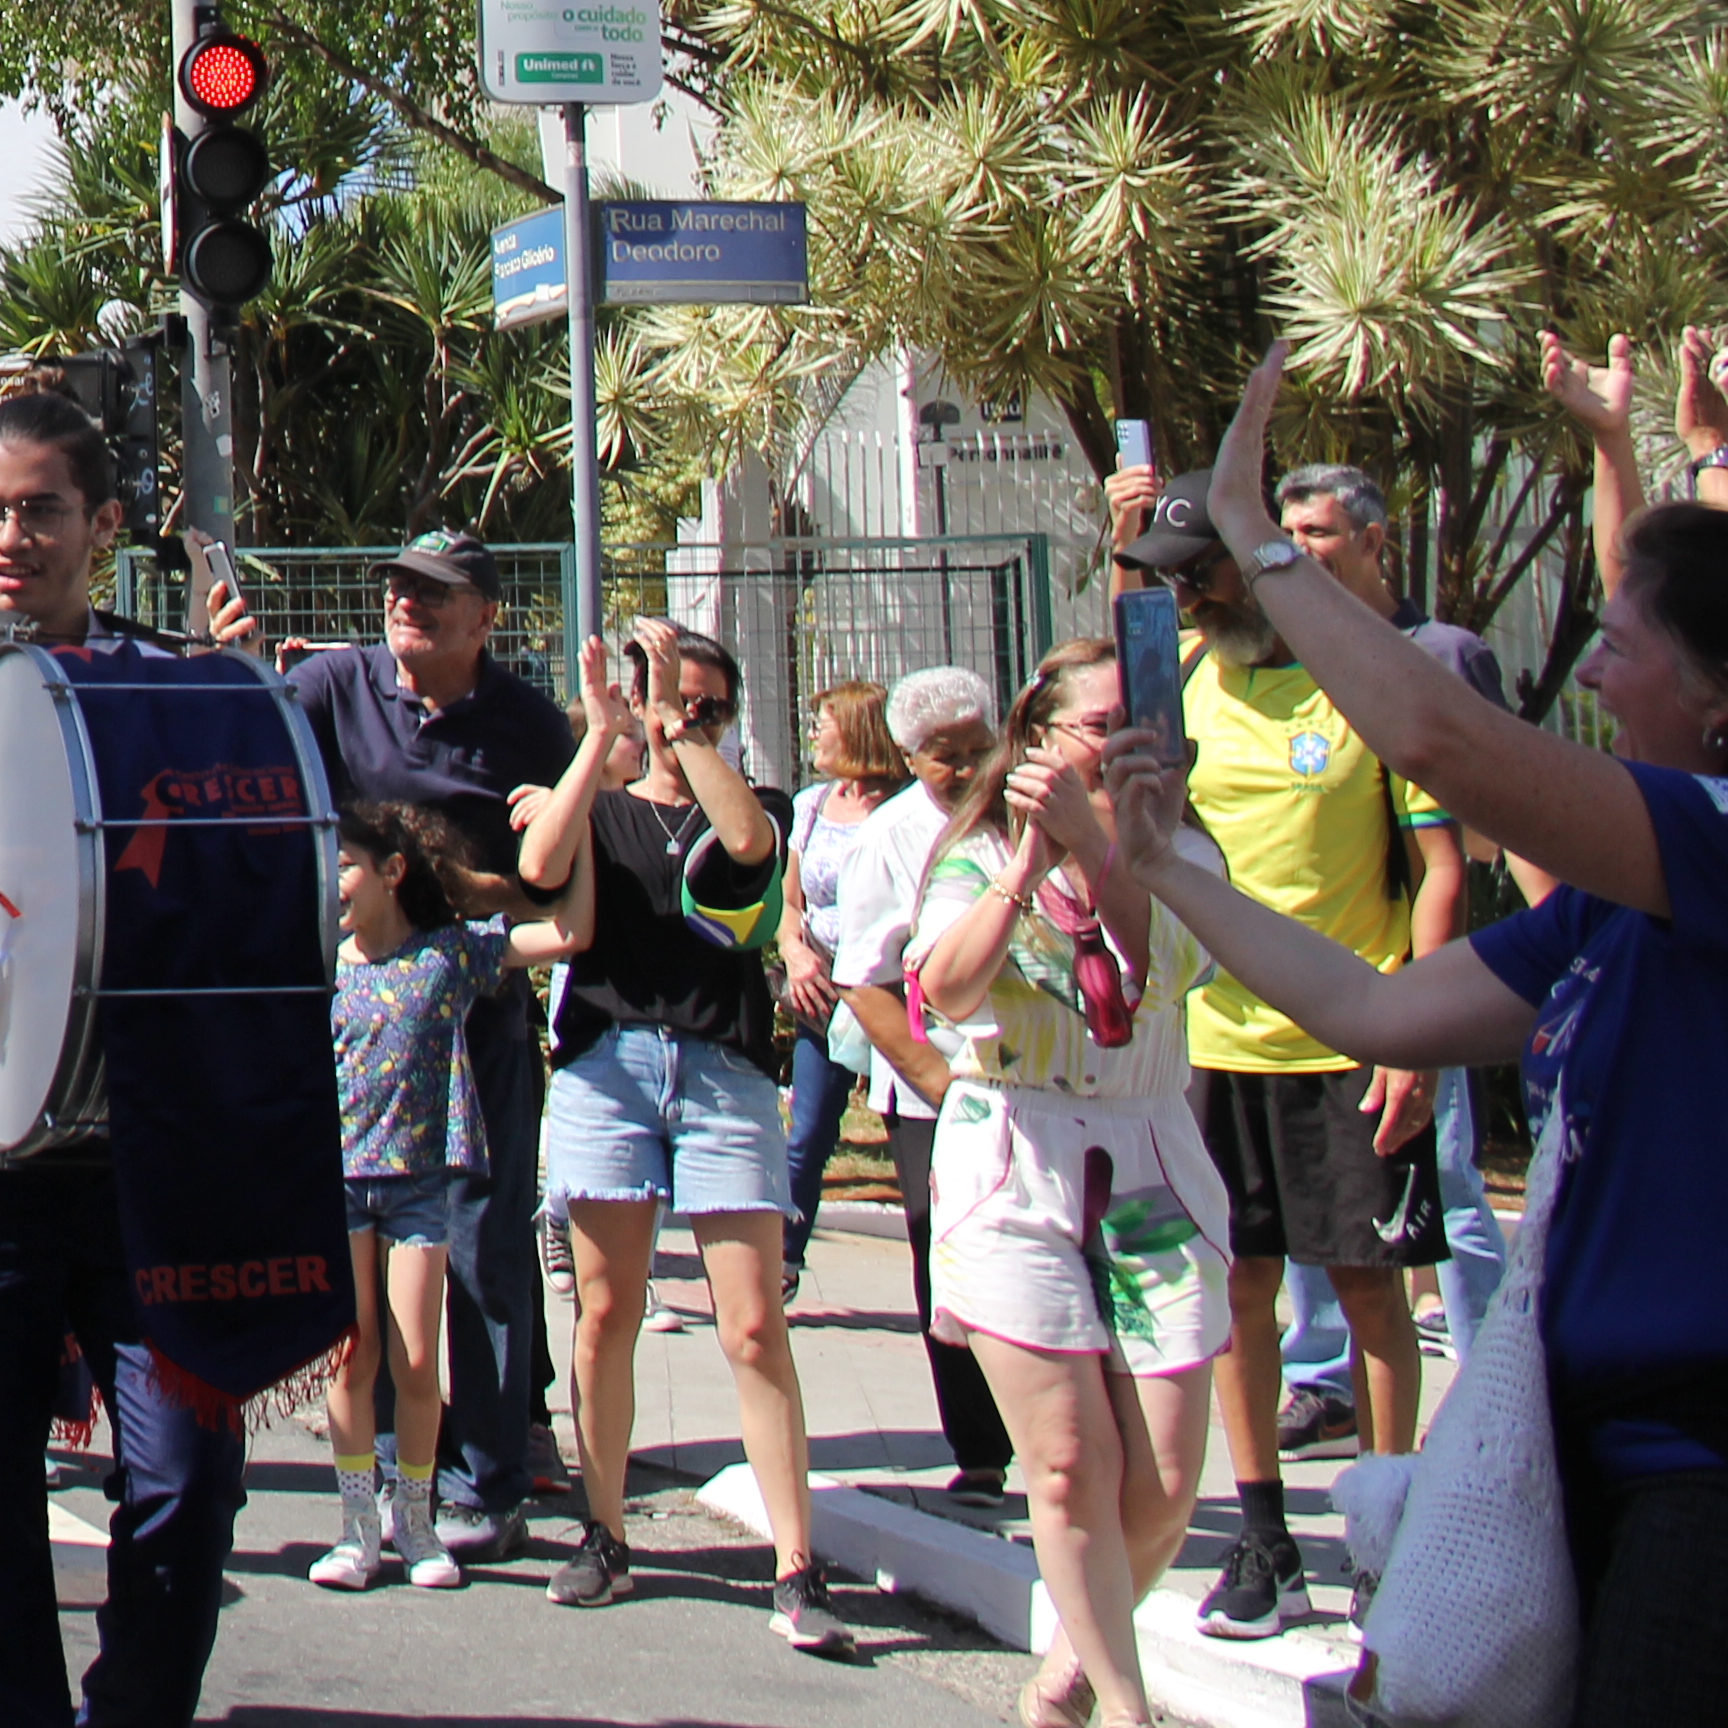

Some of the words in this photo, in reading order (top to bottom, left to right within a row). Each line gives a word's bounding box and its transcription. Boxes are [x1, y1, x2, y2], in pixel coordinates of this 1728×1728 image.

[500, 0, 534, 11] Nosso
[562, 8, 575, 22] o
[577, 5, 647, 24] cuidado
[600, 24, 644, 42] todo
[523, 57, 579, 72] Unimed
[608, 207, 665, 233] Rua
[671, 208, 786, 233] Marechal
[611, 239, 722, 263] Deodoro
[1405, 1198, 1432, 1241] AIR
